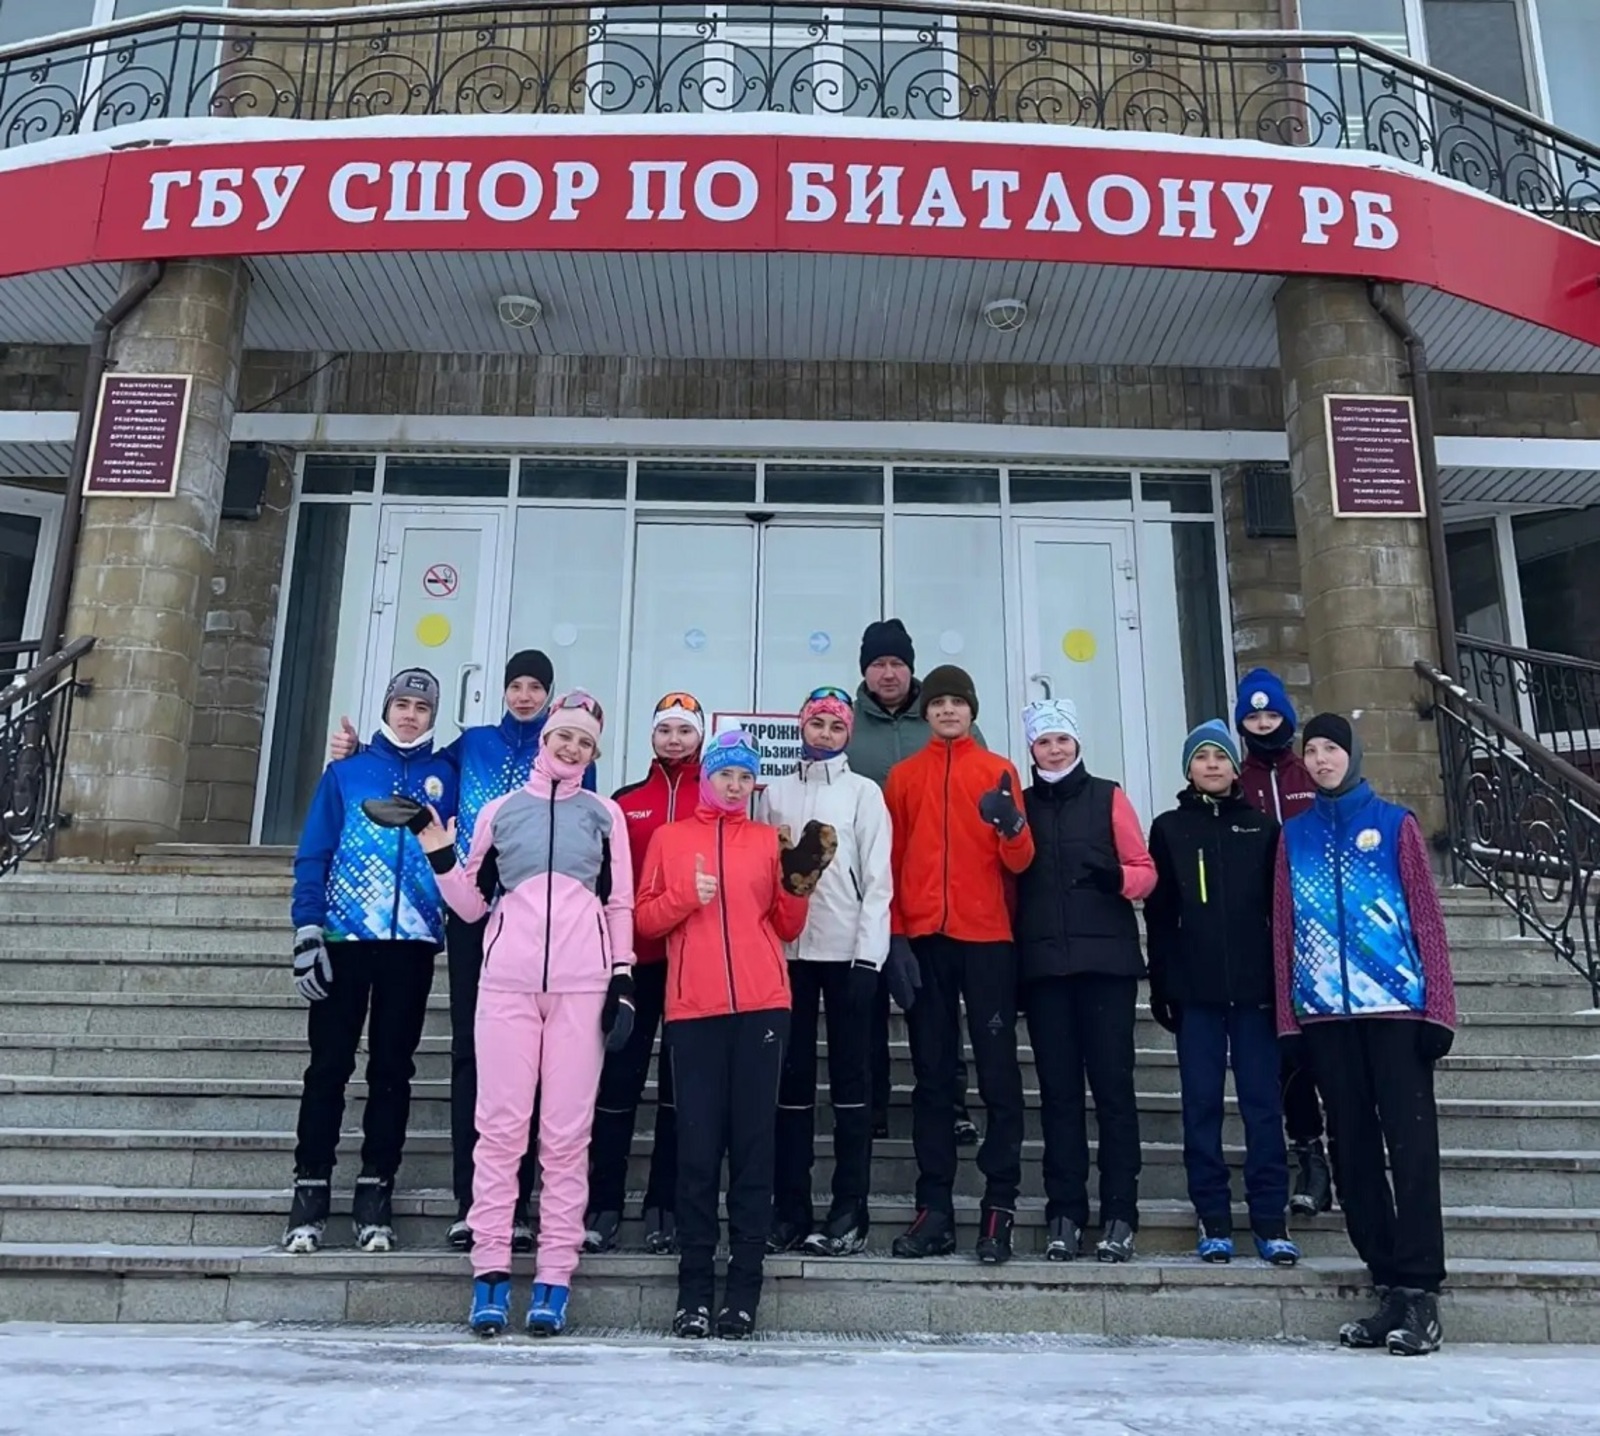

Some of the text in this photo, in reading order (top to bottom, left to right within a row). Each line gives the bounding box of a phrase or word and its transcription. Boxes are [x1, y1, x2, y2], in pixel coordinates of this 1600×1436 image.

[142, 160, 1399, 250] ГБУ СШОР ПО БИАТЛОНУ РБ
